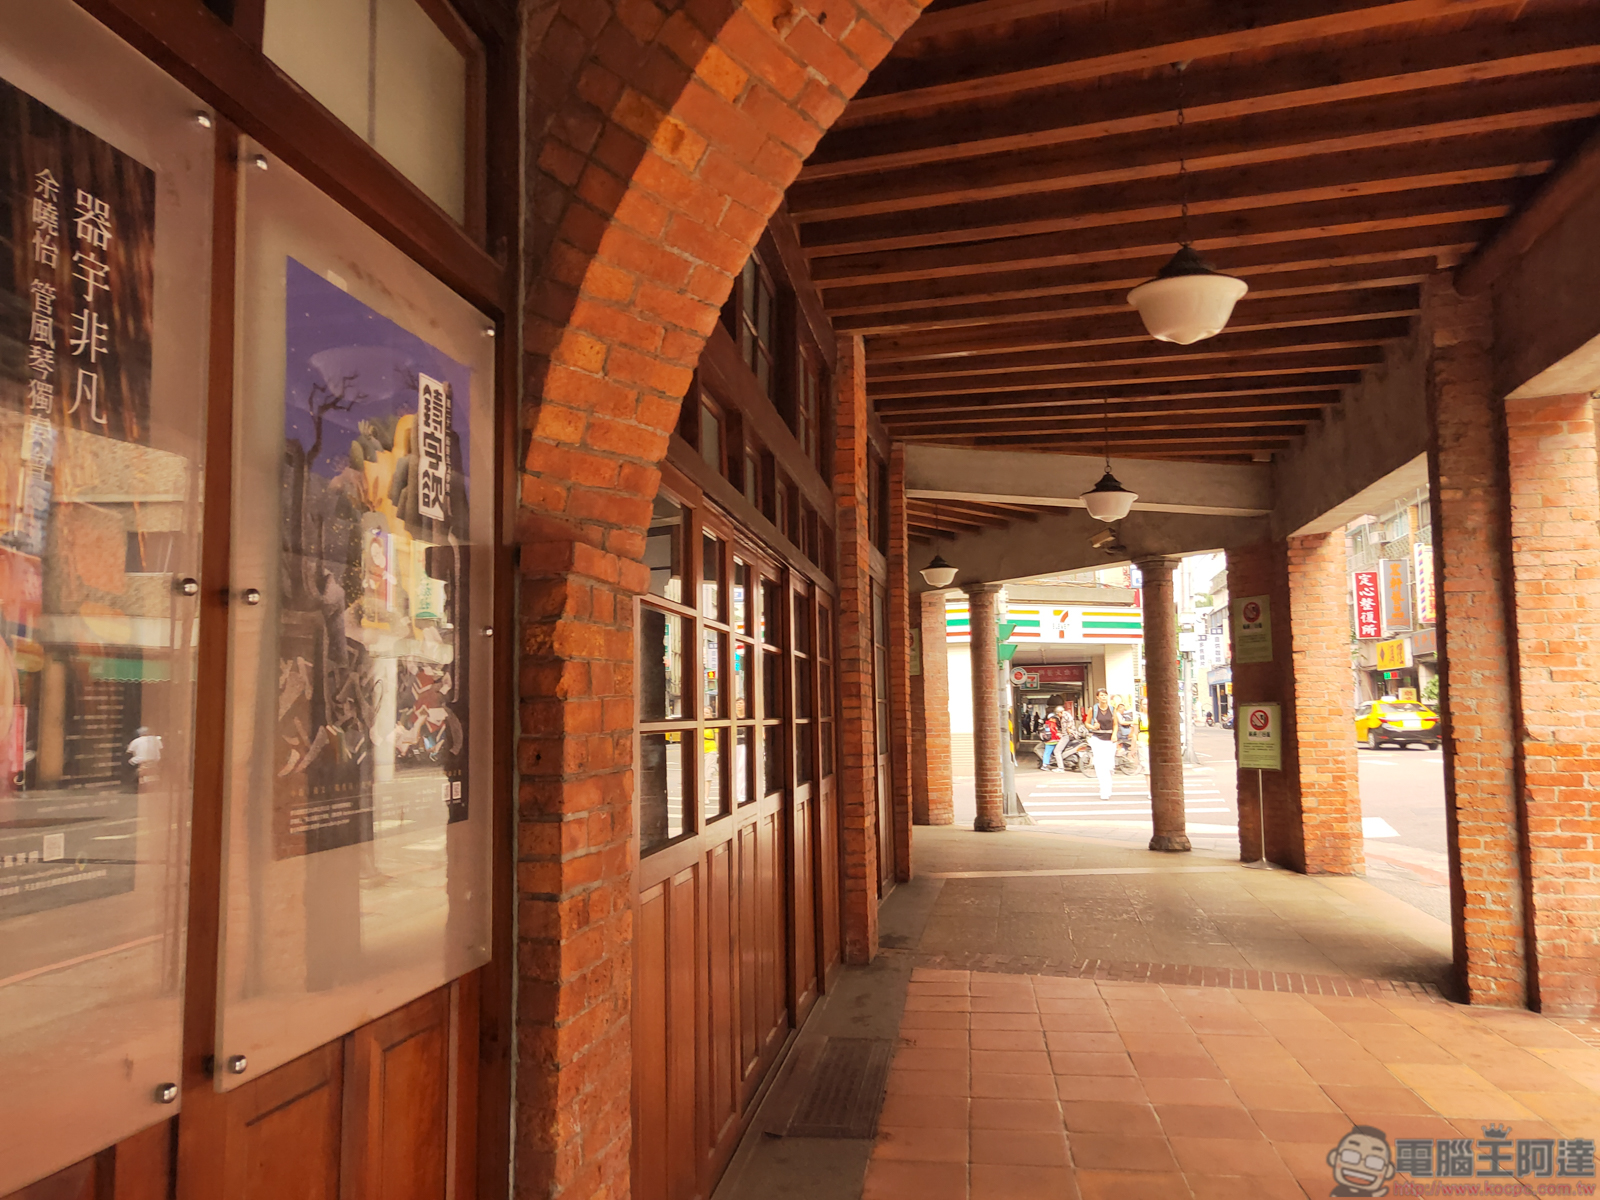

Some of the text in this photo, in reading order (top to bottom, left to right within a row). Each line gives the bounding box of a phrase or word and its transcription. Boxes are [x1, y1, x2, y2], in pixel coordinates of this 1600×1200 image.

[31, 167, 60, 270] 余曉怡
[68, 188, 113, 426] 器宇非凡
[1358, 573, 1378, 637] 定心整復所
